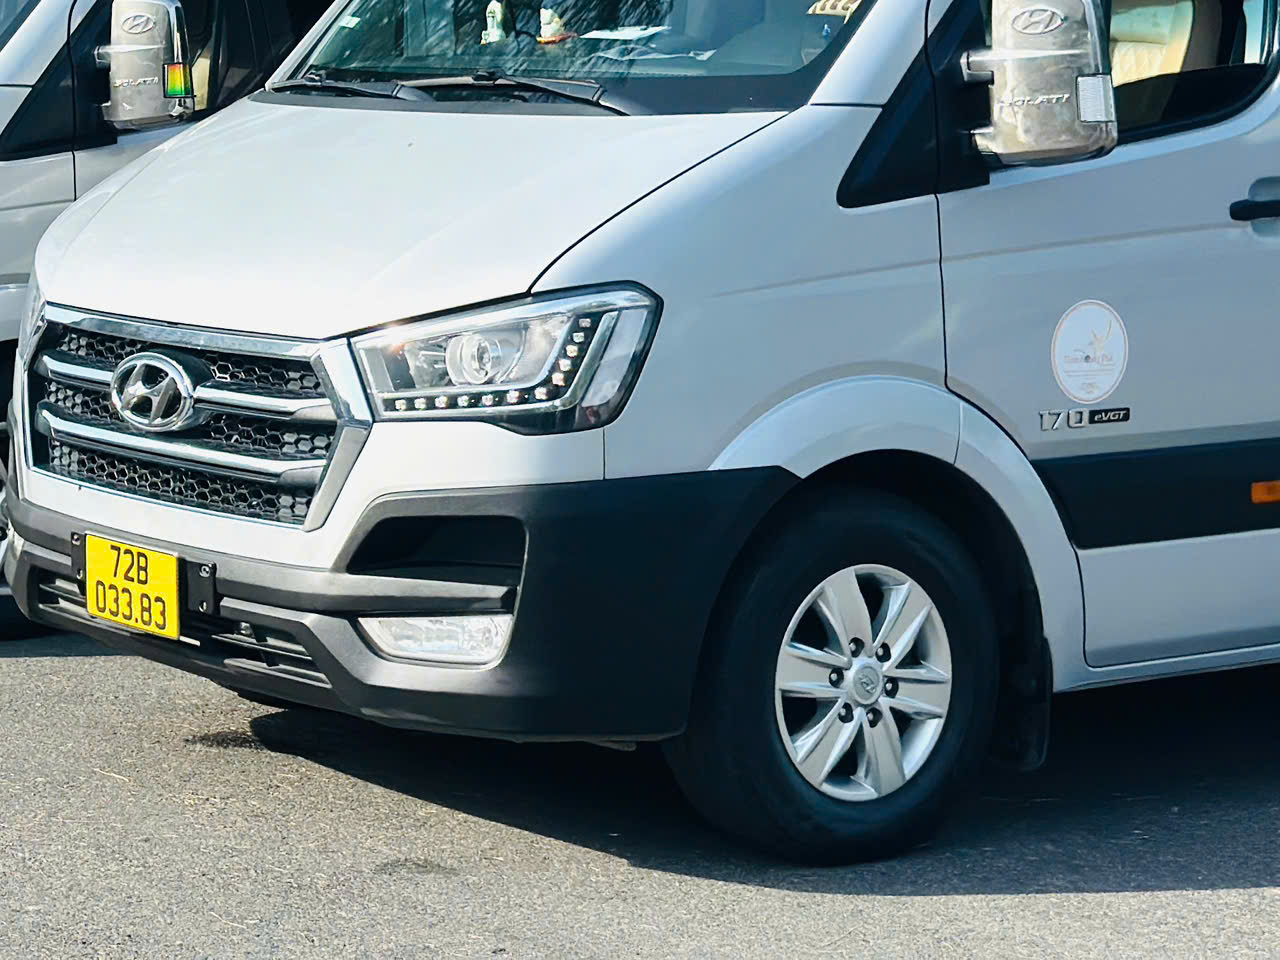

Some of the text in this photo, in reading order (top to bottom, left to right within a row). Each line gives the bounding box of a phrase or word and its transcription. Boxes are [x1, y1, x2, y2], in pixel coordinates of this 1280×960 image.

[1039, 407, 1127, 431] 170 eVGT
[110, 544, 149, 585] 72B
[95, 580, 167, 630] 033.83
